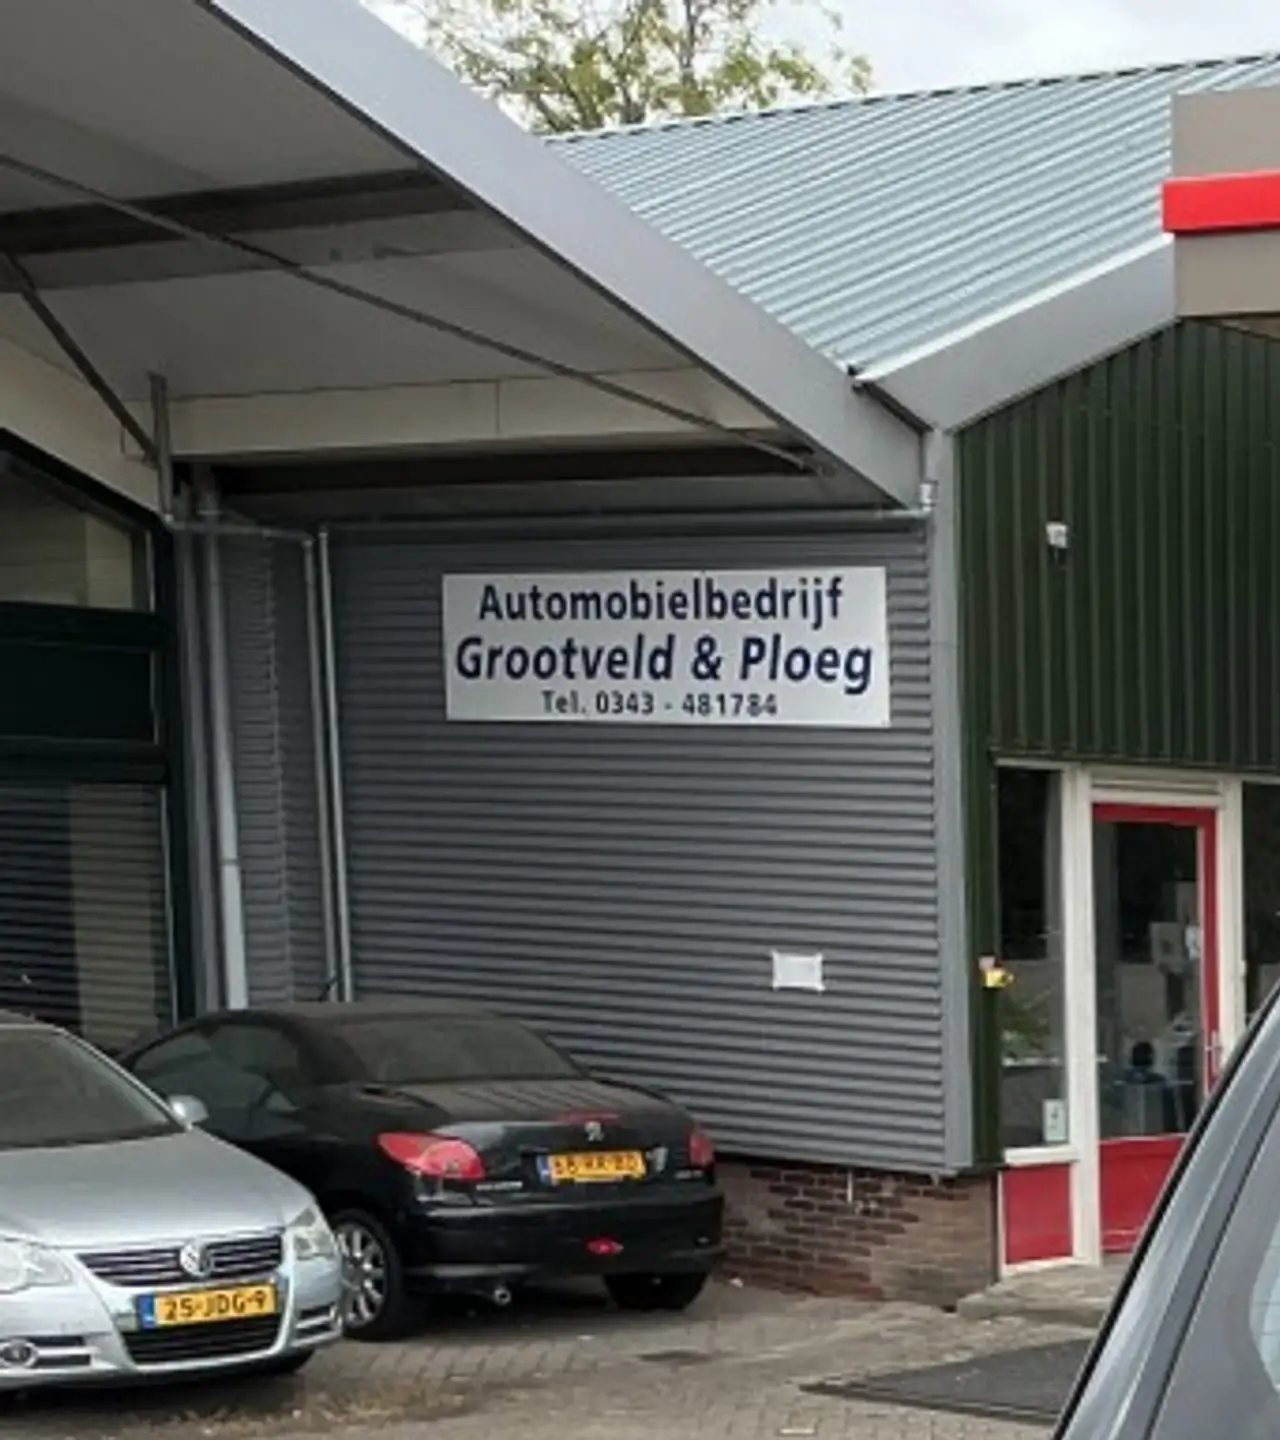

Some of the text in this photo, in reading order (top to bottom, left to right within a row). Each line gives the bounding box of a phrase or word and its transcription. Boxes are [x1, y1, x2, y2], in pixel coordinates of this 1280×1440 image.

[479, 577, 844, 631] Automobielbedrijf
[455, 633, 873, 695] Grootveld & Ploeg
[542, 690, 586, 715] Tel.
[595, 691, 655, 715] 0343
[681, 692, 778, 716] 481784
[164, 1290, 267, 1321] 25-JDG-9
